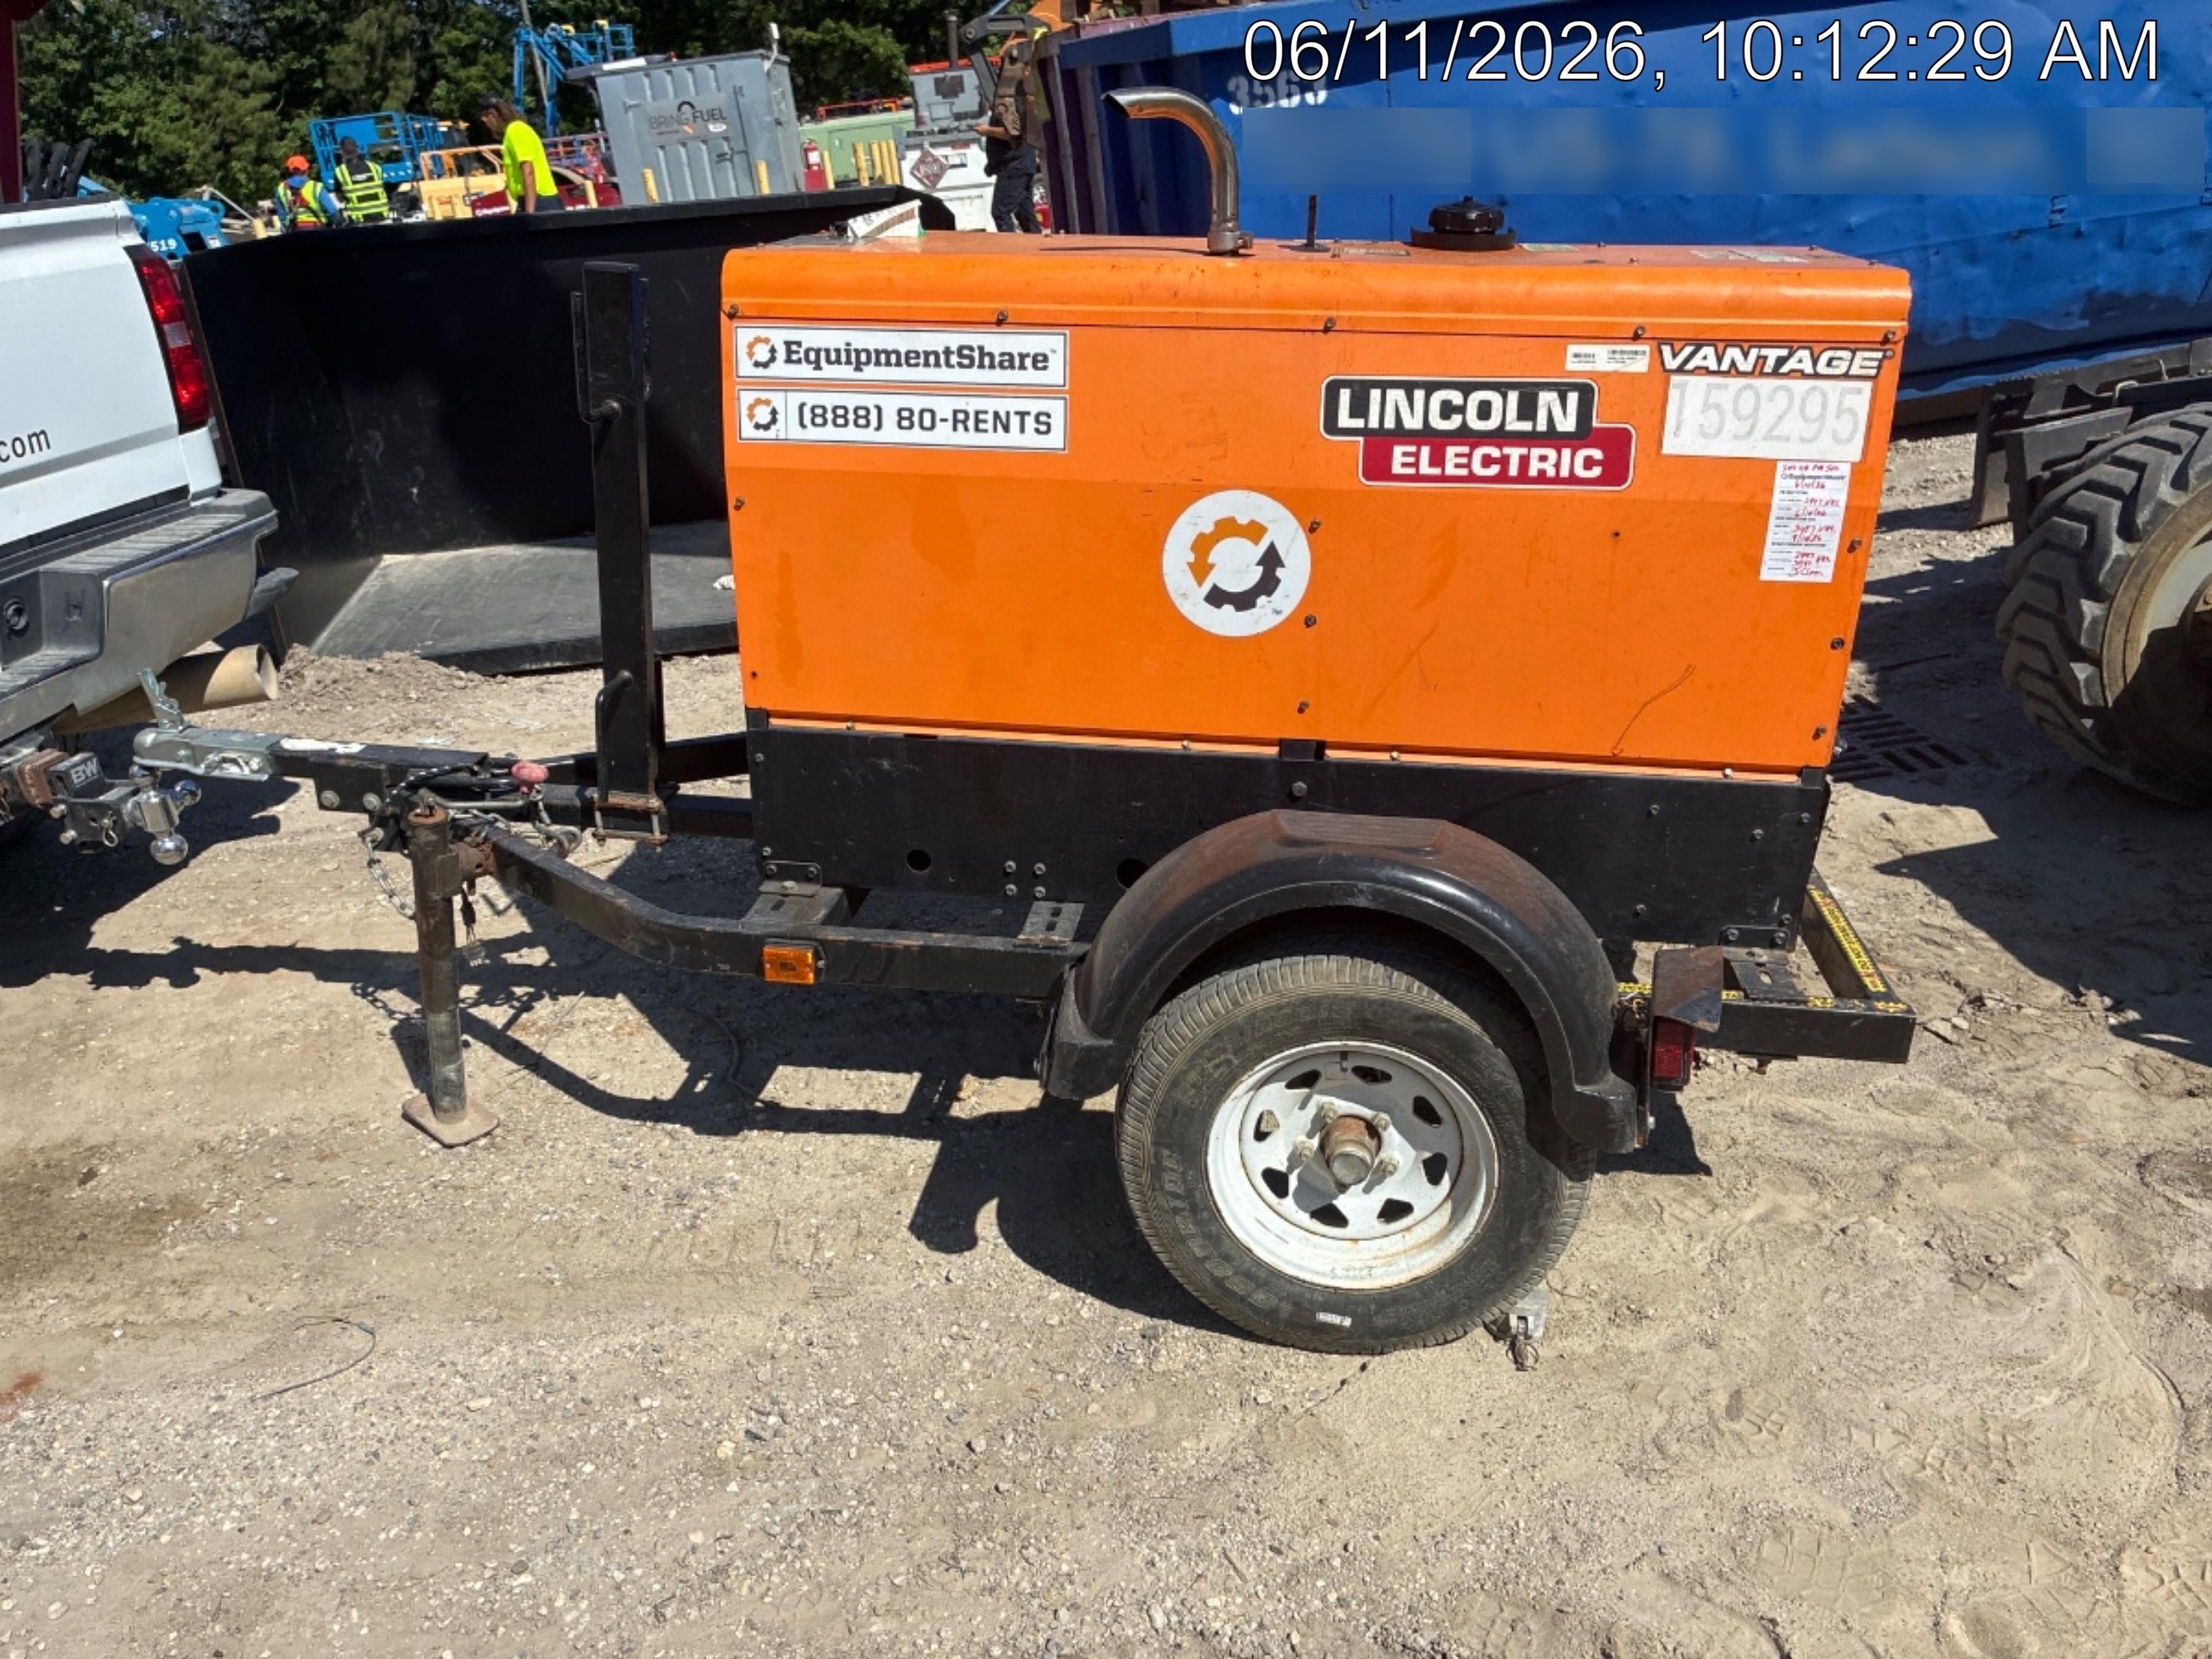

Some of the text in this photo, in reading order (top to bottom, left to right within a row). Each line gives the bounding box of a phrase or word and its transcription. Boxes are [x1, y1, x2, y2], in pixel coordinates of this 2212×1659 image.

[692, 107, 727, 124] FUEL
[783, 340, 1050, 371] EquipmentShare
[1659, 343, 1885, 377] VANTAGE
[798, 402, 1053, 436] (888) 80-RENTS
[1337, 388, 1579, 433] LINCOLN
[1670, 380, 1864, 445] 159295
[1390, 445, 1604, 479] ELECTRIC
